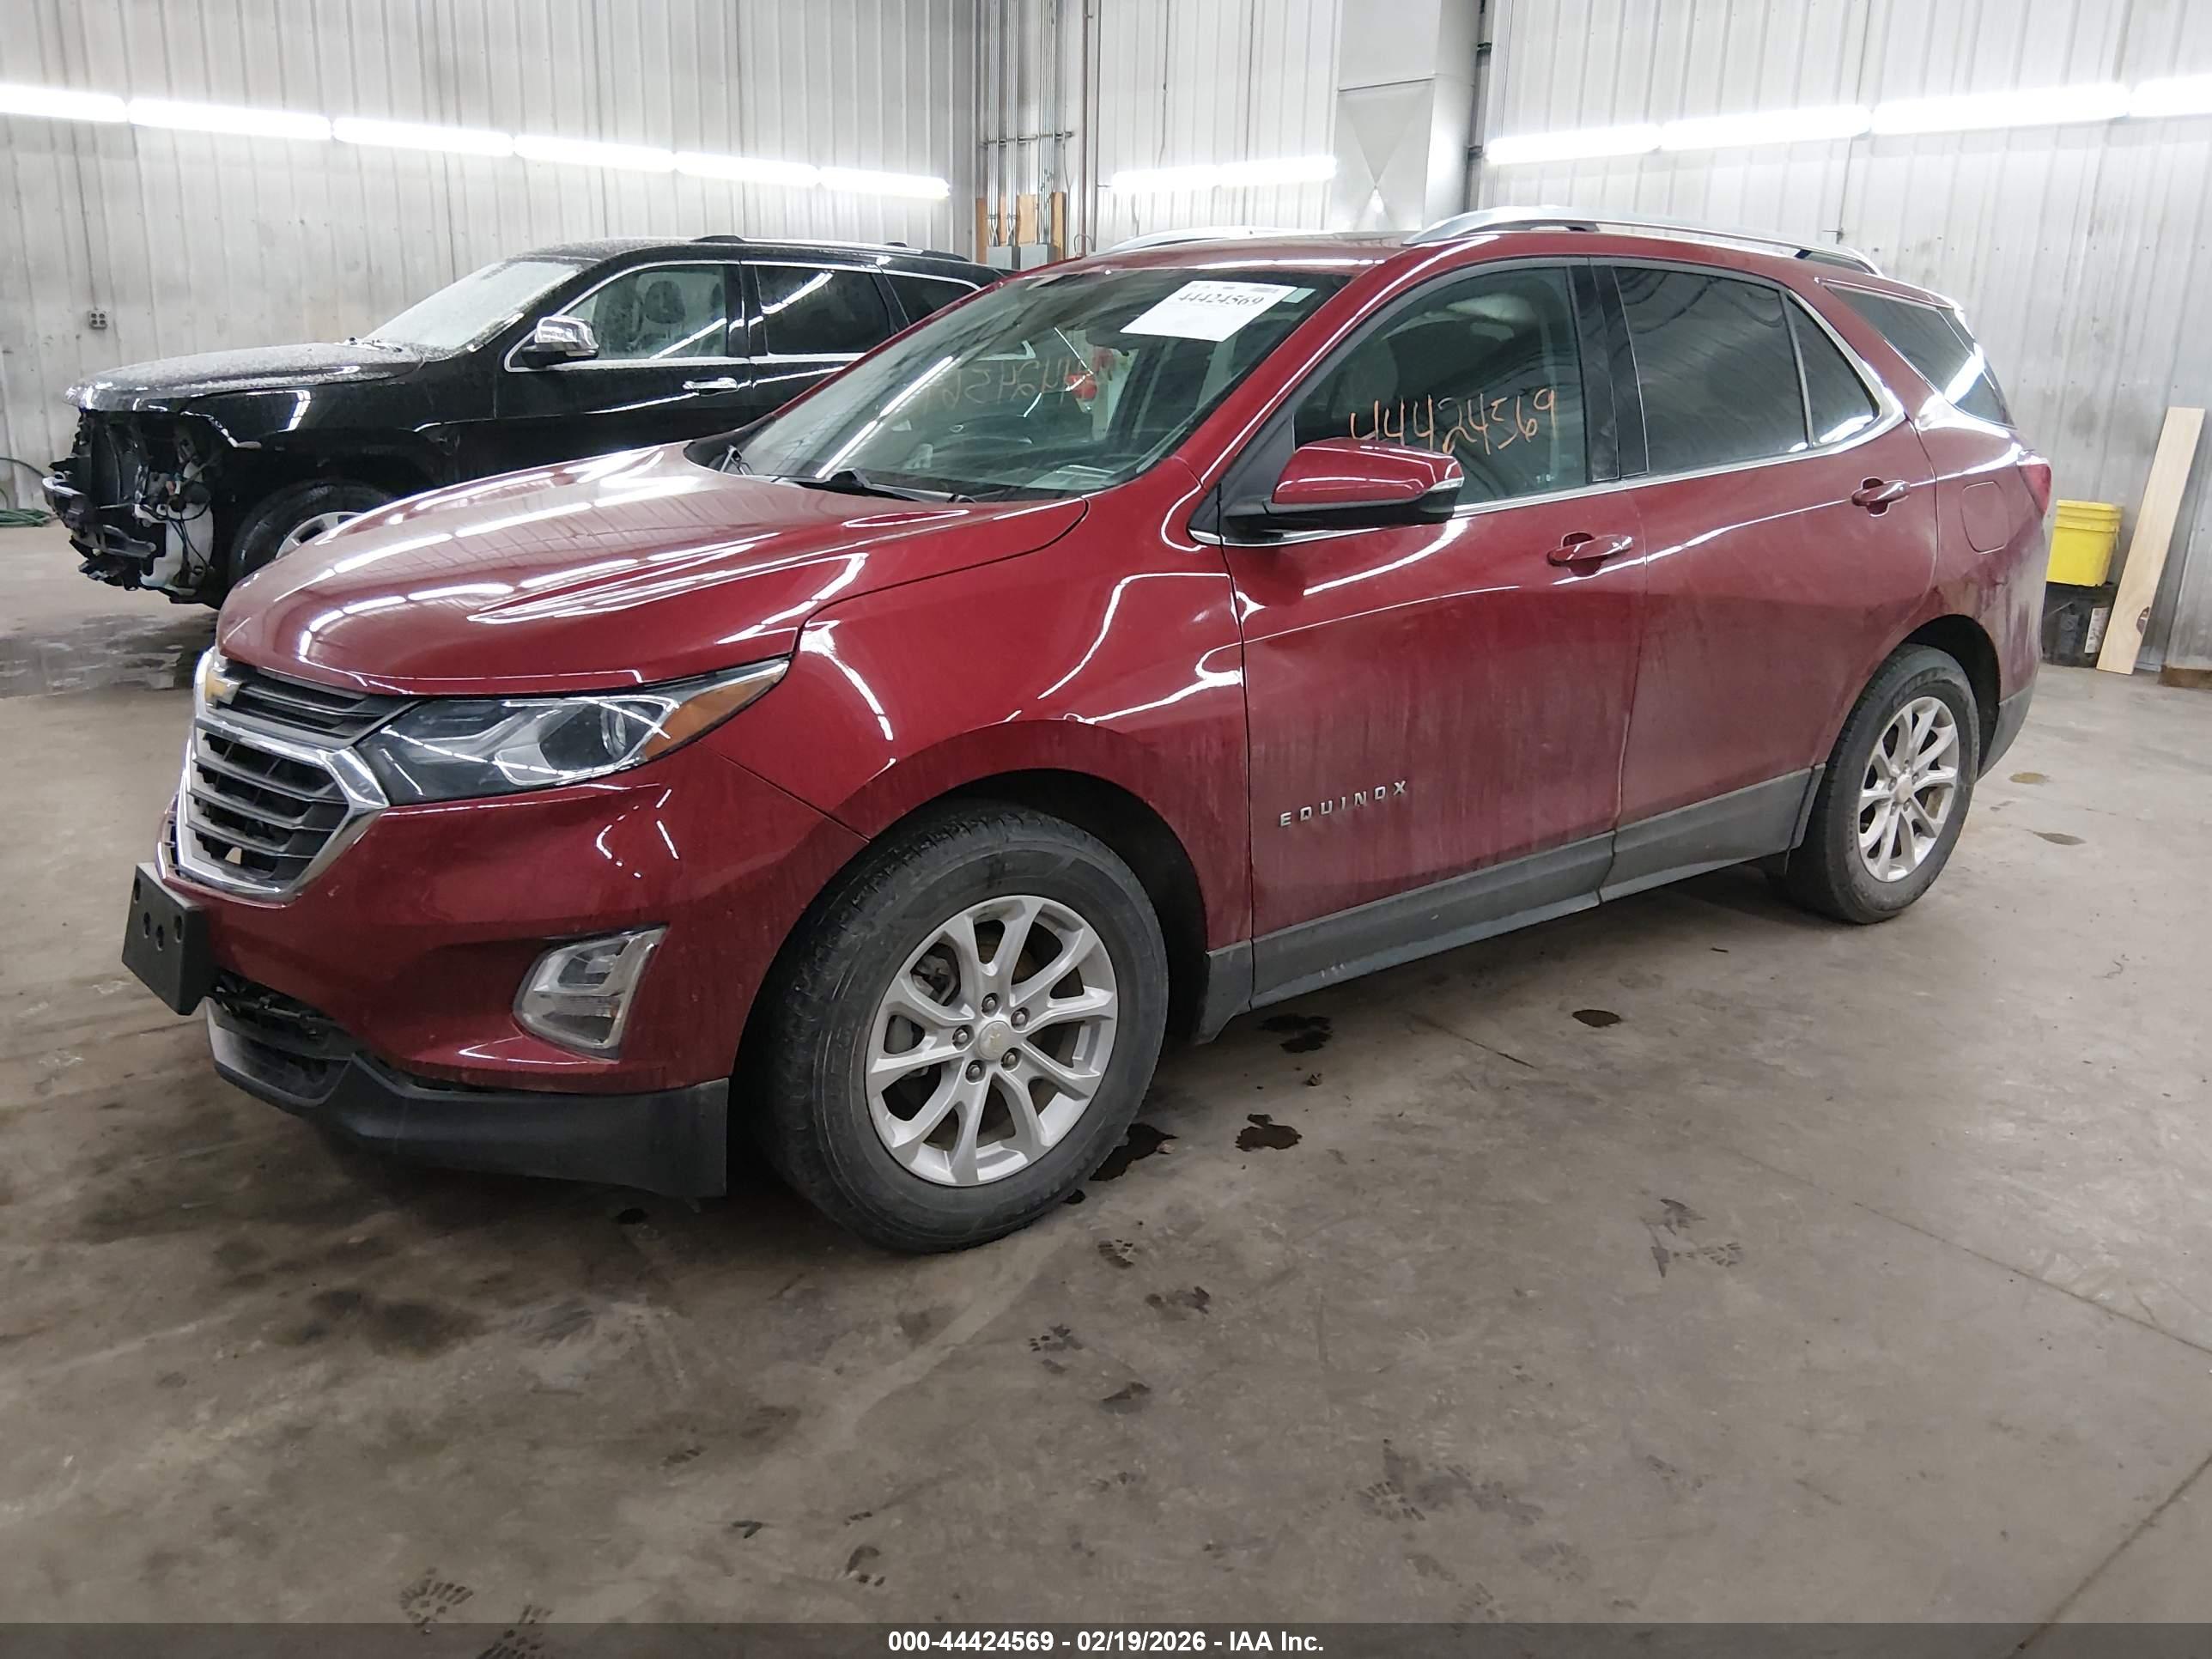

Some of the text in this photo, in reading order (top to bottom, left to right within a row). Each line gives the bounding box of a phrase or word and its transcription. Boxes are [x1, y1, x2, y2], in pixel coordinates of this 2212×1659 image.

[1177, 292, 1265, 306] 44424569
[1349, 388, 1557, 456] 44424569
[1279, 780, 1407, 827] EQUINOX
